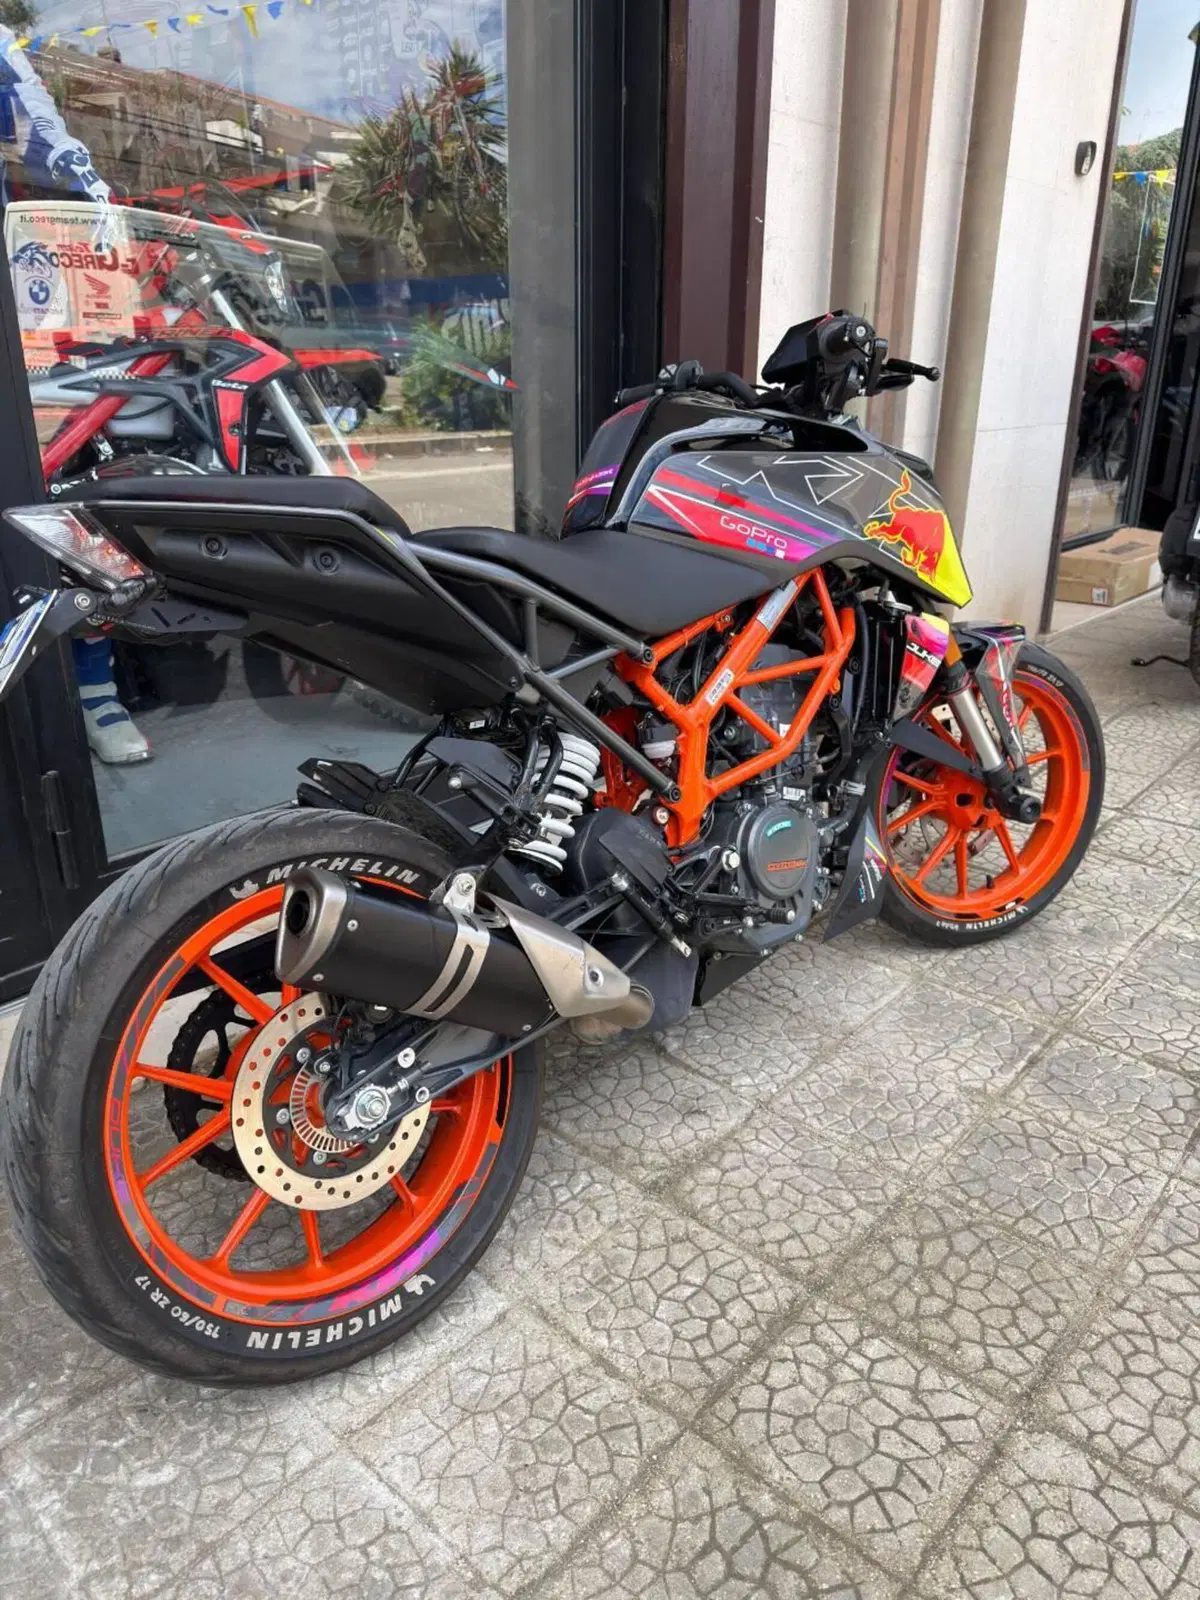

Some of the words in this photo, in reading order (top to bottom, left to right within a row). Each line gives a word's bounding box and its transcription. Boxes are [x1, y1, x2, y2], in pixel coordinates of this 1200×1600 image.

[720, 515, 788, 550] GoPro
[134, 1275, 151, 1290] 17
[150, 1287, 169, 1309] ZR
[170, 1307, 220, 1339] 150/60
[246, 1294, 402, 1350] MICHELIN
